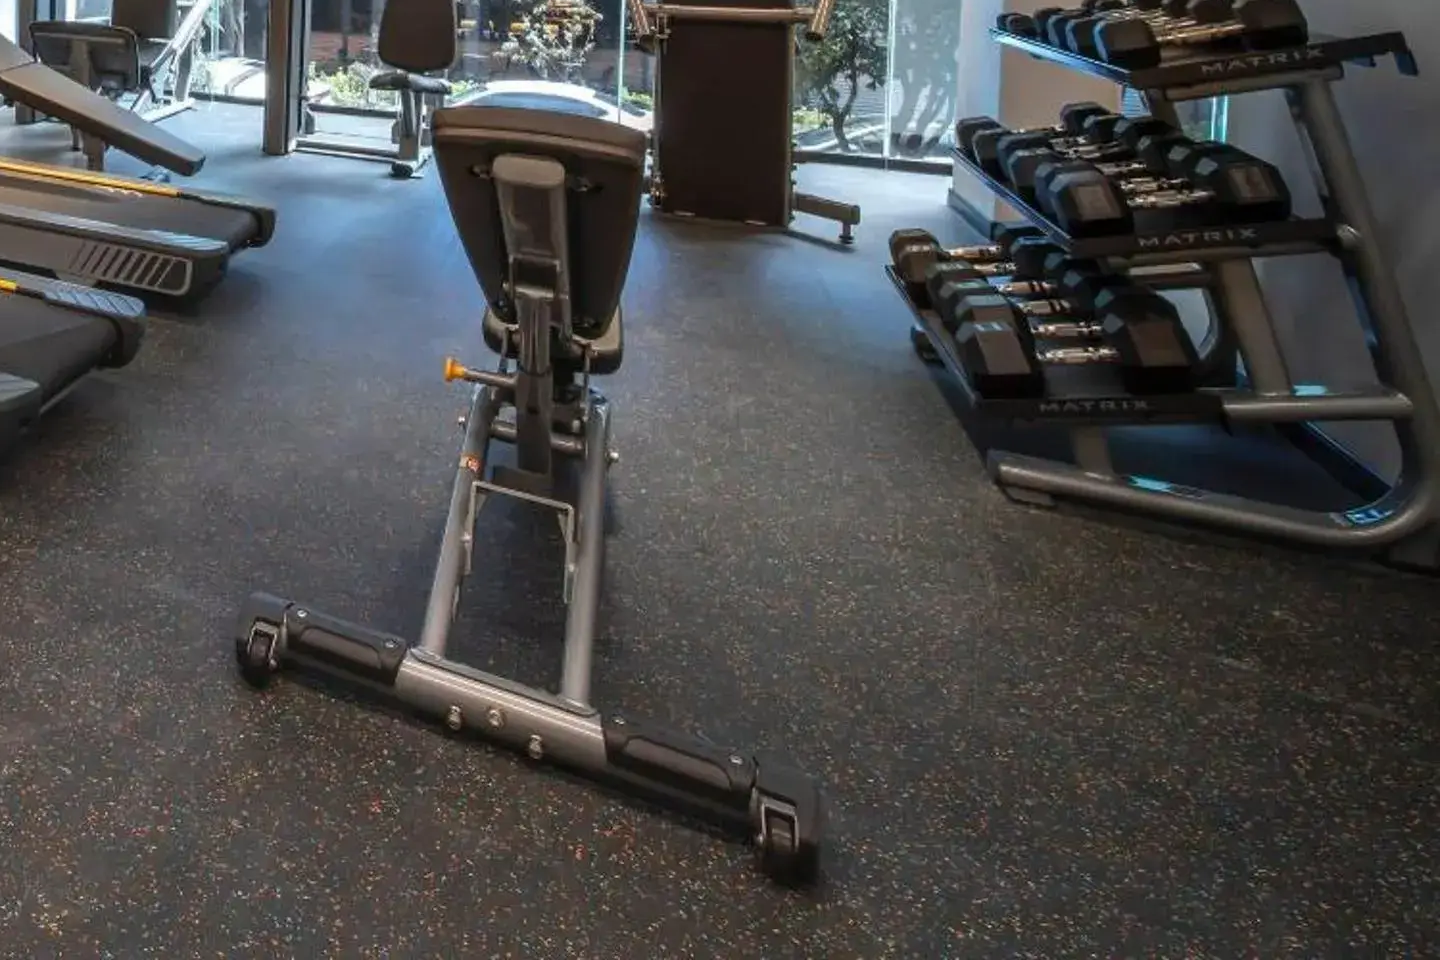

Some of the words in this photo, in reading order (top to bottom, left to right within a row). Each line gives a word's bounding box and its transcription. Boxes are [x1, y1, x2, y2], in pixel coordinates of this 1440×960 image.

[1200, 48, 1324, 74] MATRIX
[1138, 228, 1257, 247] MATRIX
[1039, 399, 1149, 413] MATRIX
